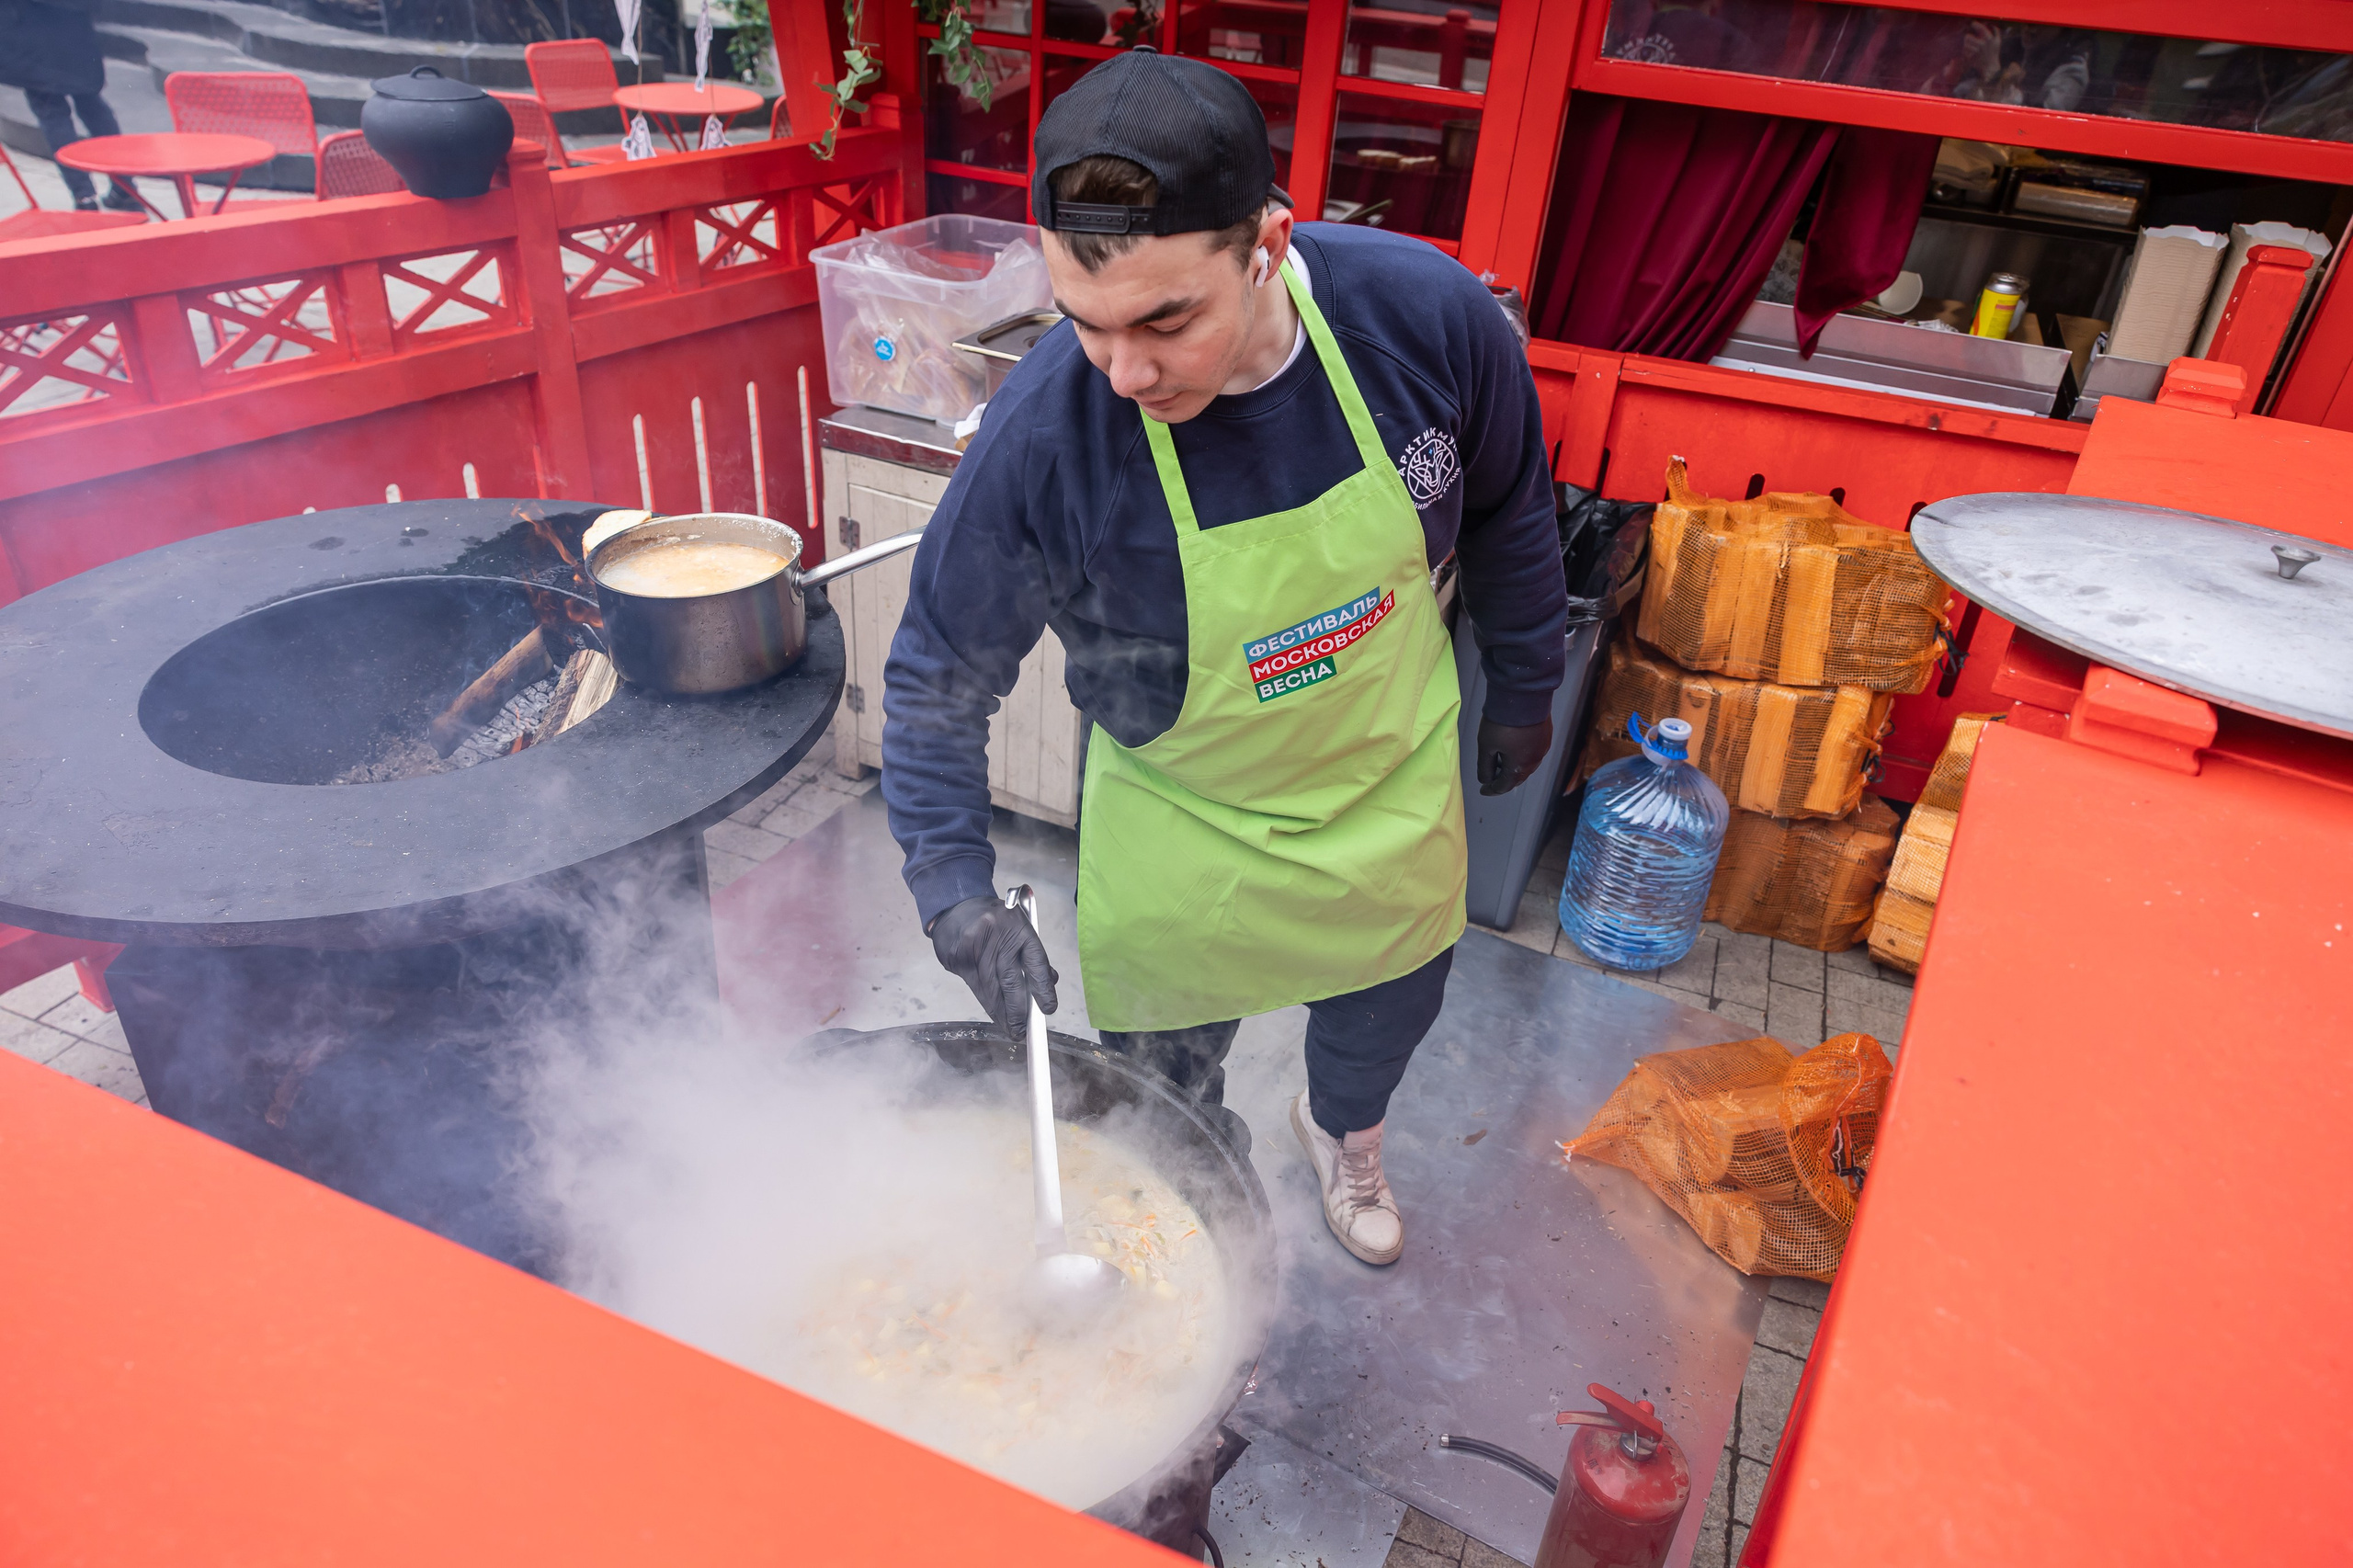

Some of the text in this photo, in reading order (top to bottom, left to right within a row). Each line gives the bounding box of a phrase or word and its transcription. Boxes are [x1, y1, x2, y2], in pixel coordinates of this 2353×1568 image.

[1398, 427, 1436, 477] АРКТИК
[1412, 494, 1443, 510] БИЛЬНАЯ
[1248, 596, 1378, 657] ФЕСТИВАЛЬ
[1253, 594, 1393, 679] МОСКОВСКАЯ
[1259, 662, 1333, 699] ВЕСНА
